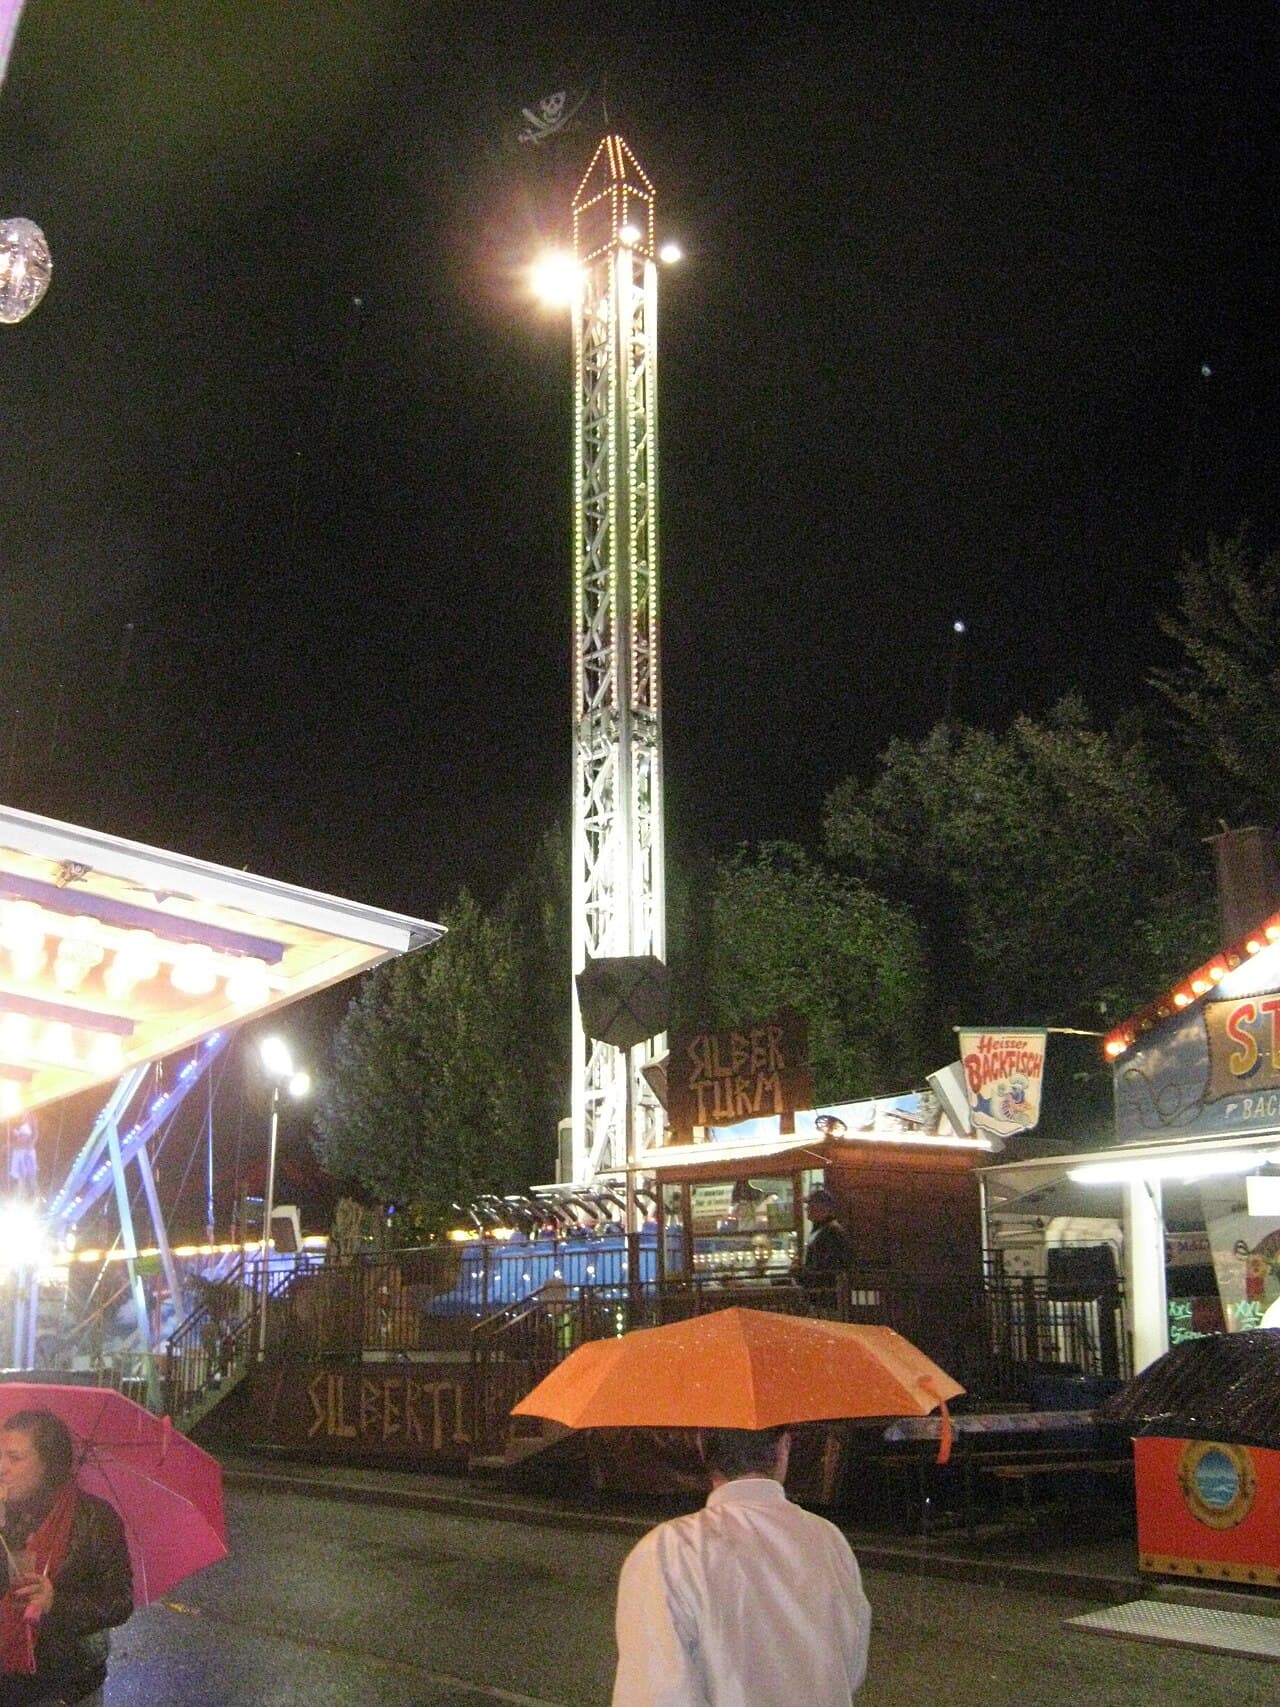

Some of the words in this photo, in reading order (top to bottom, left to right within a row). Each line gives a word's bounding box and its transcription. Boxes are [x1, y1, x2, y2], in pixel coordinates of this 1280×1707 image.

[687, 1026, 785, 1081] SILBER
[964, 1050, 1043, 1095] BACKFISCH
[688, 1072, 783, 1125] TURM
[1243, 1095, 1280, 1119] BAC
